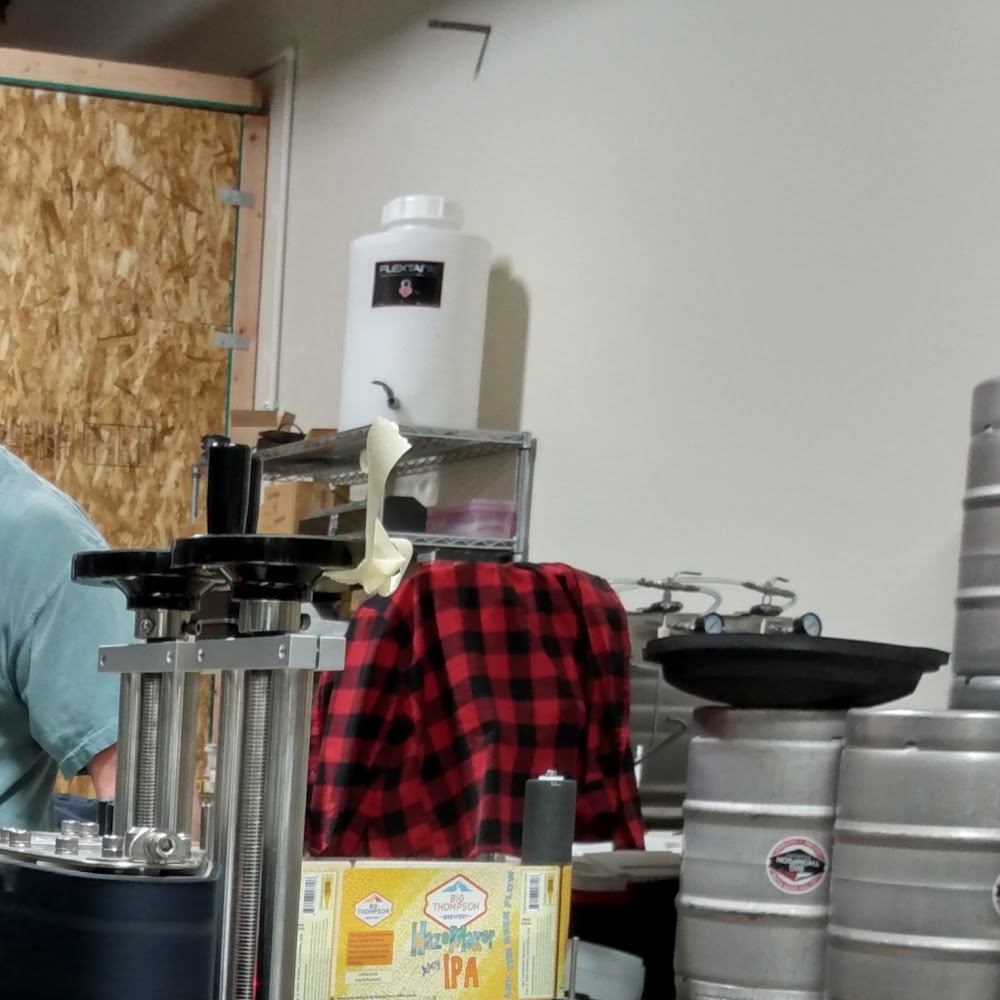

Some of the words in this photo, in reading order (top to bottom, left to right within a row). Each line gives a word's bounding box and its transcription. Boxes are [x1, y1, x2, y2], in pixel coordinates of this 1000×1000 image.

[449, 894, 464, 903] BIG
[433, 902, 480, 912] THOMPSON
[443, 953, 479, 990] IPA
